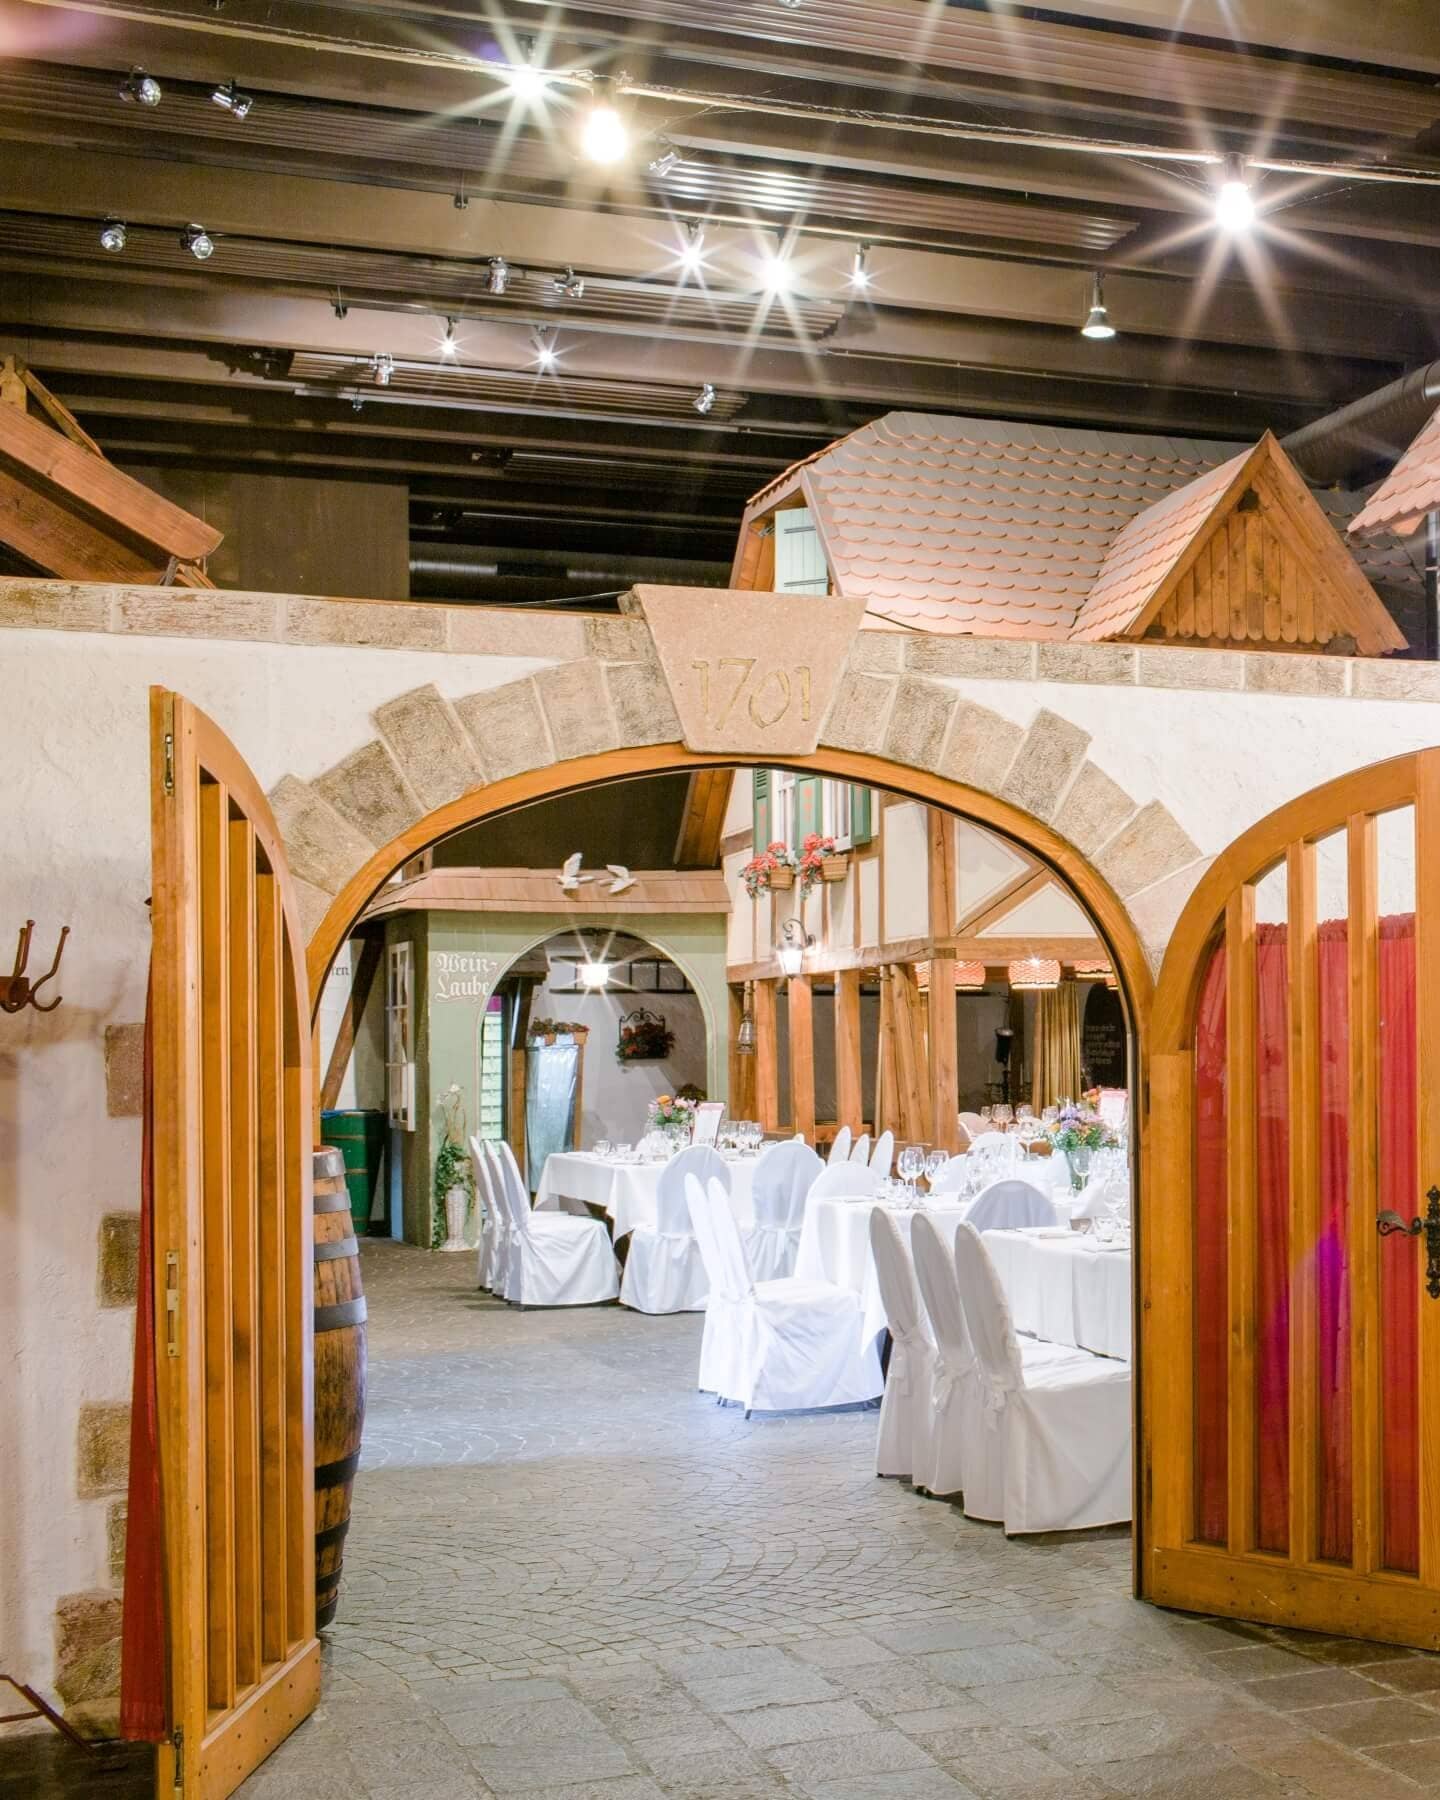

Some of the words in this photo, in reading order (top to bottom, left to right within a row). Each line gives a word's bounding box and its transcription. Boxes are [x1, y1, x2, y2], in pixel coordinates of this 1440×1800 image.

[690, 657, 812, 731] 1701
[434, 951, 498, 974] Wein-
[434, 975, 490, 1003] Laube
